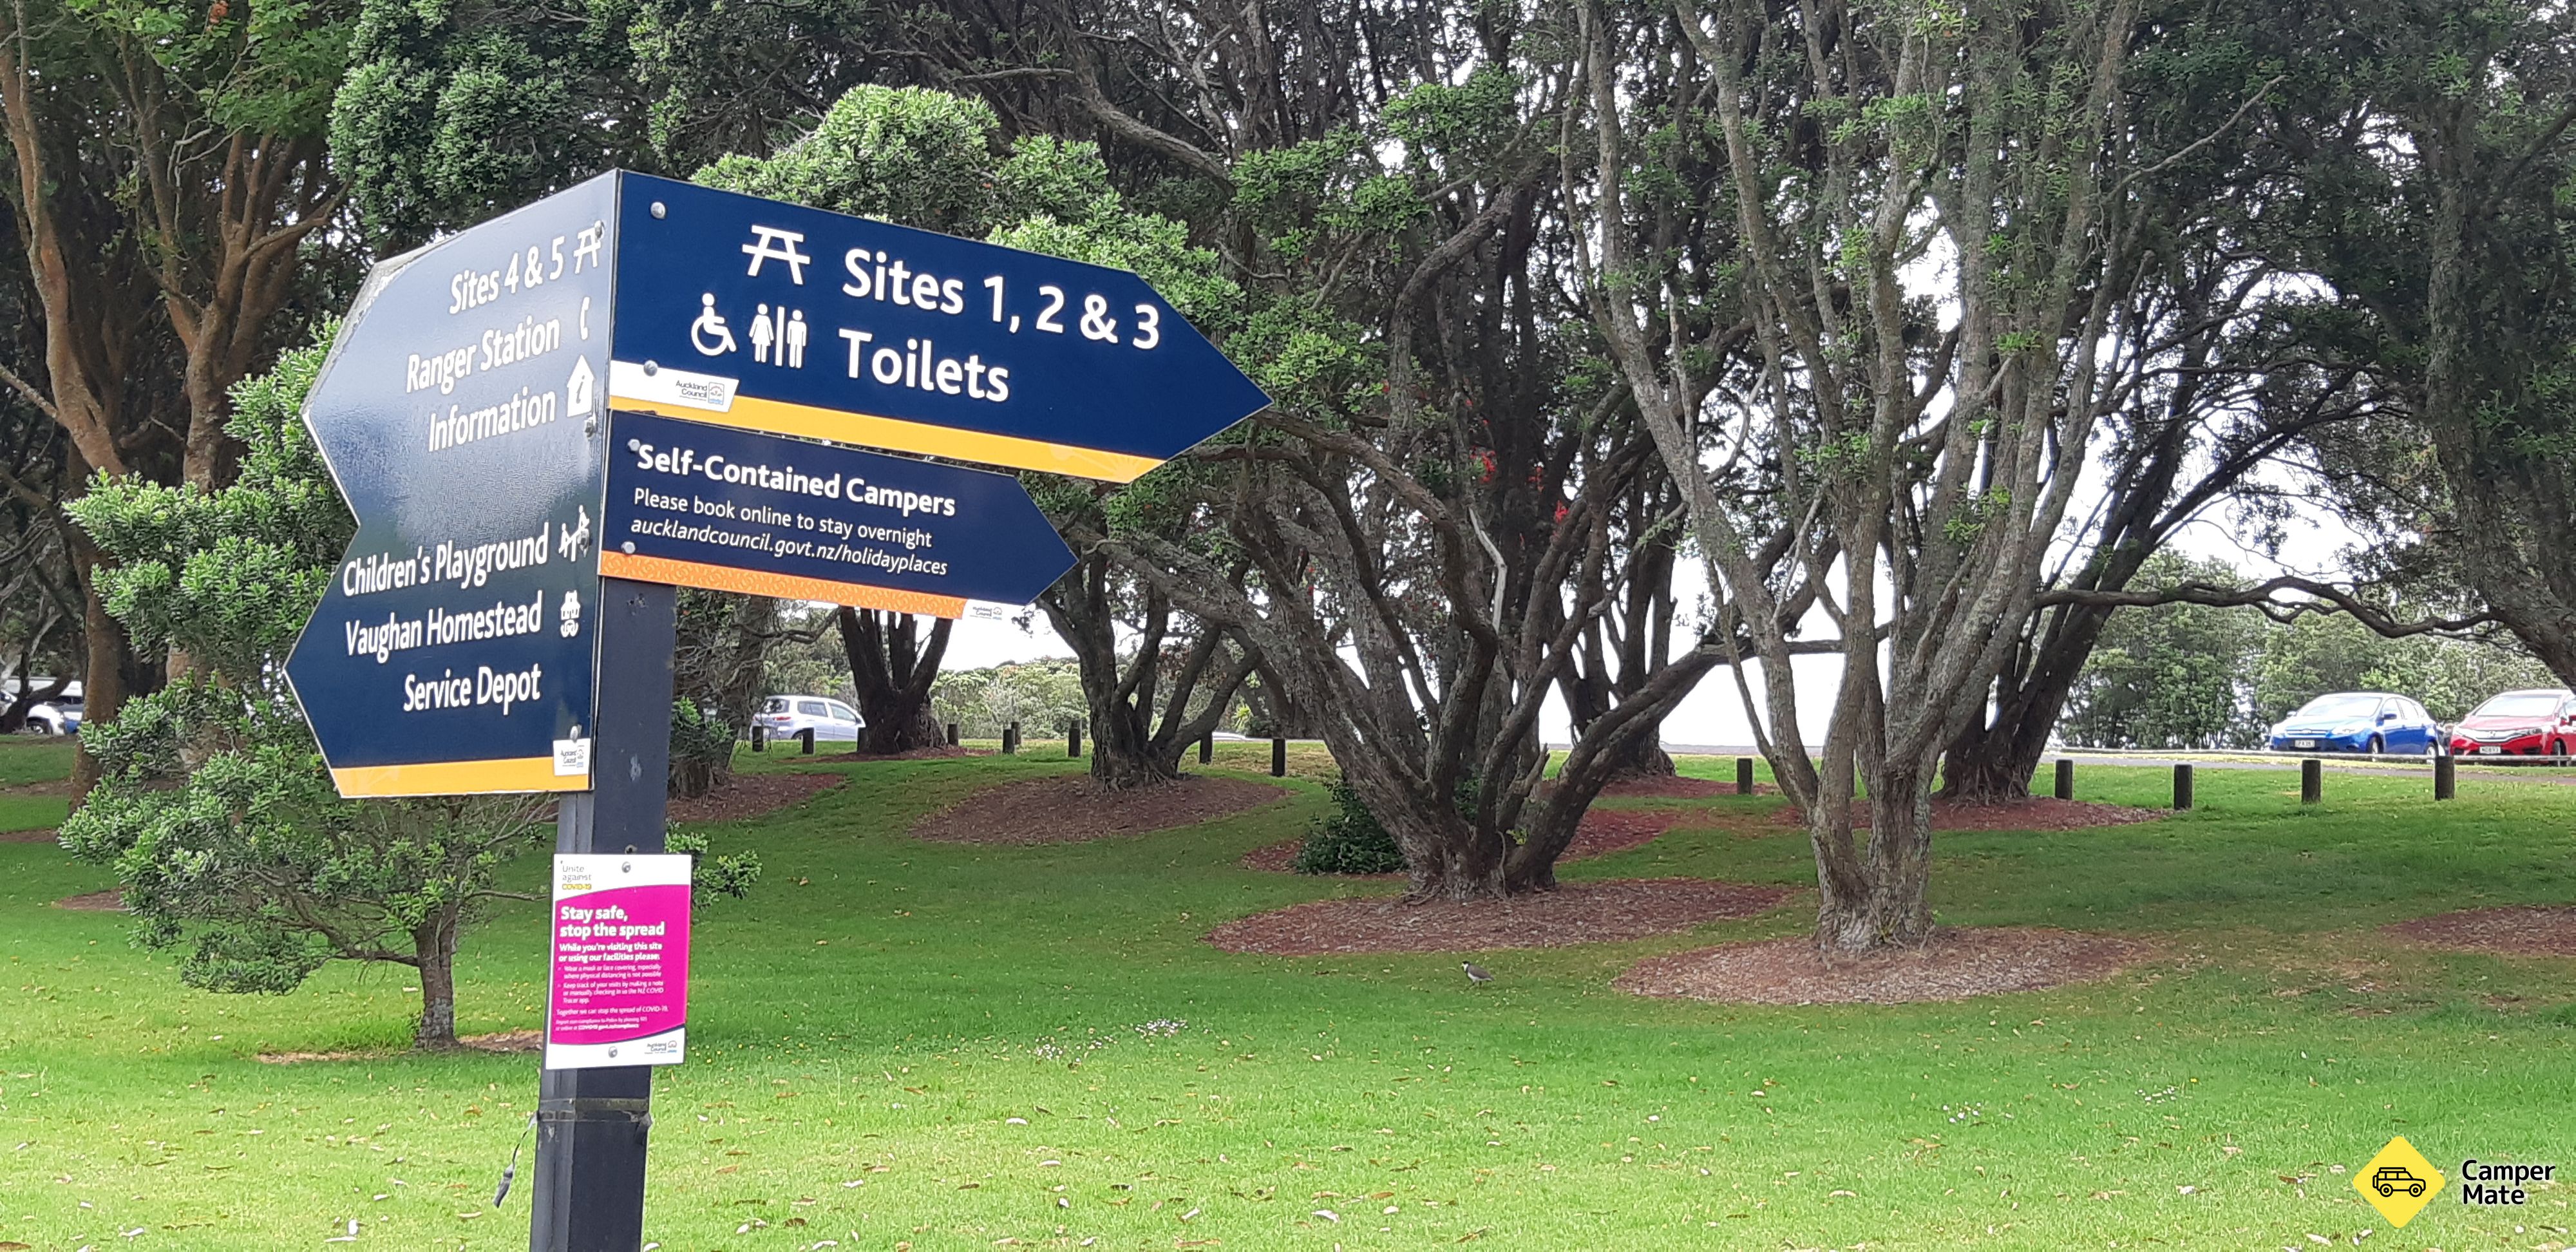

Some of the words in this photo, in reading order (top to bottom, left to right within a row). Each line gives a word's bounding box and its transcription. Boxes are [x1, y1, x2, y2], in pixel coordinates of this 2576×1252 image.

[450, 270, 500, 314] Sites
[504, 252, 519, 294] 4
[525, 247, 543, 290] &
[549, 236, 565, 281] 5
[842, 248, 965, 315] Sites
[983, 275, 1020, 334] 1,
[1036, 285, 1065, 334] 2
[1079, 293, 1119, 345] &
[1133, 305, 1160, 350] 3
[406, 345, 477, 395] Ranger
[481, 316, 560, 370] Station
[838, 328, 1010, 403] Toilets
[676, 380, 707, 391] Auckland
[681, 388, 707, 398] Council
[429, 386, 556, 452] Information
[637, 444, 840, 498] Self-Contained
[846, 479, 956, 517] Campers
[630, 518, 948, 575] aucklandcouncil.govt.nz/holidayplaces
[634, 488, 688, 512] Please
[694, 495, 735, 520] book
[740, 505, 791, 527] online
[797, 513, 814, 529] to
[819, 517, 853, 540] stay
[857, 525, 933, 549] overnight
[343, 545, 430, 596] Children's
[435, 522, 549, 589] Playground
[346, 612, 422, 663] Vaughan
[427, 590, 543, 645] Homestead
[403, 669, 471, 711] Service
[477, 663, 541, 715] Depot
[562, 874, 592, 882] against
[560, 924, 591, 940] stop
[593, 922, 617, 936] the
[619, 921, 665, 940] spread
[561, 906, 593, 924] Stay
[595, 905, 628, 922] safe,
[568, 954, 588, 963] using
[603, 953, 634, 961] facilities
[607, 942, 632, 952] visiting
[649, 942, 662, 950] site
